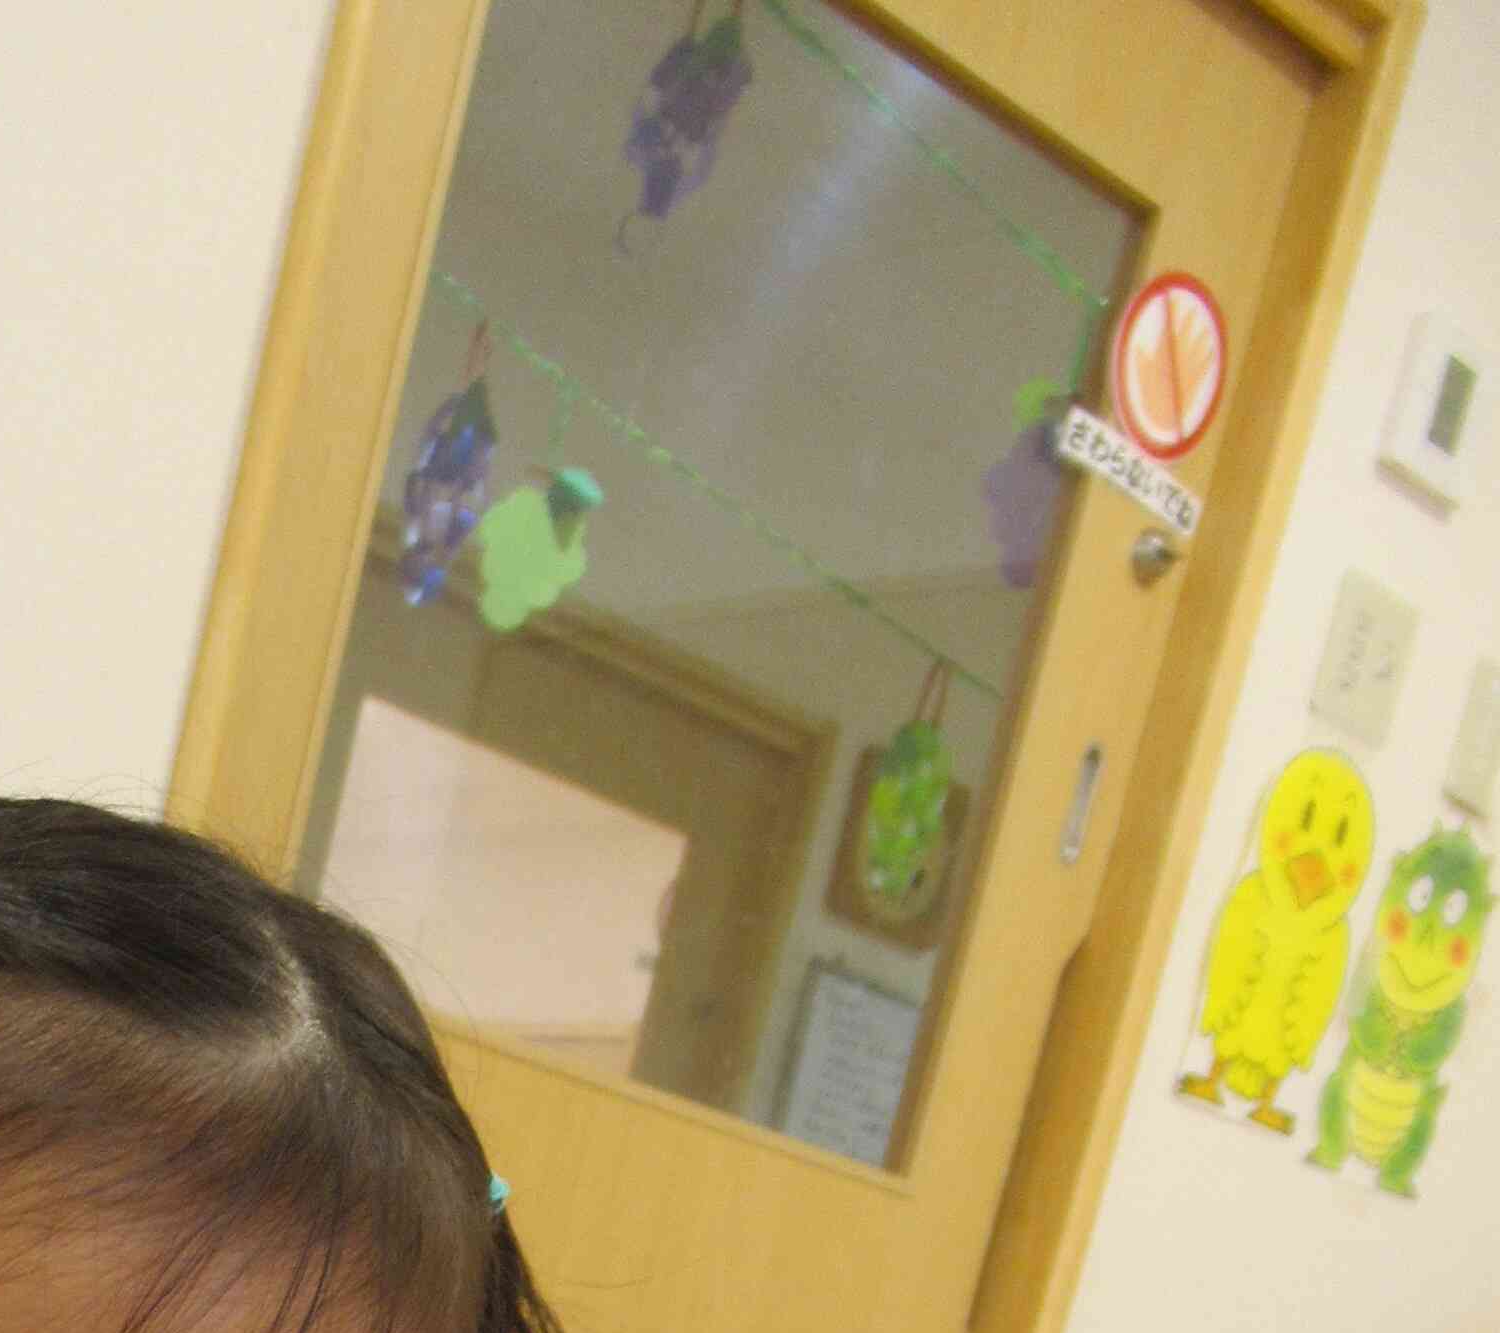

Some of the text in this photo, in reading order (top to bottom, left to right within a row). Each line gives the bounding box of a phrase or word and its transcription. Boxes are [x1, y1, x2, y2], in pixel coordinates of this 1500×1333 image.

[1065, 418, 1196, 530] さわらないでね
